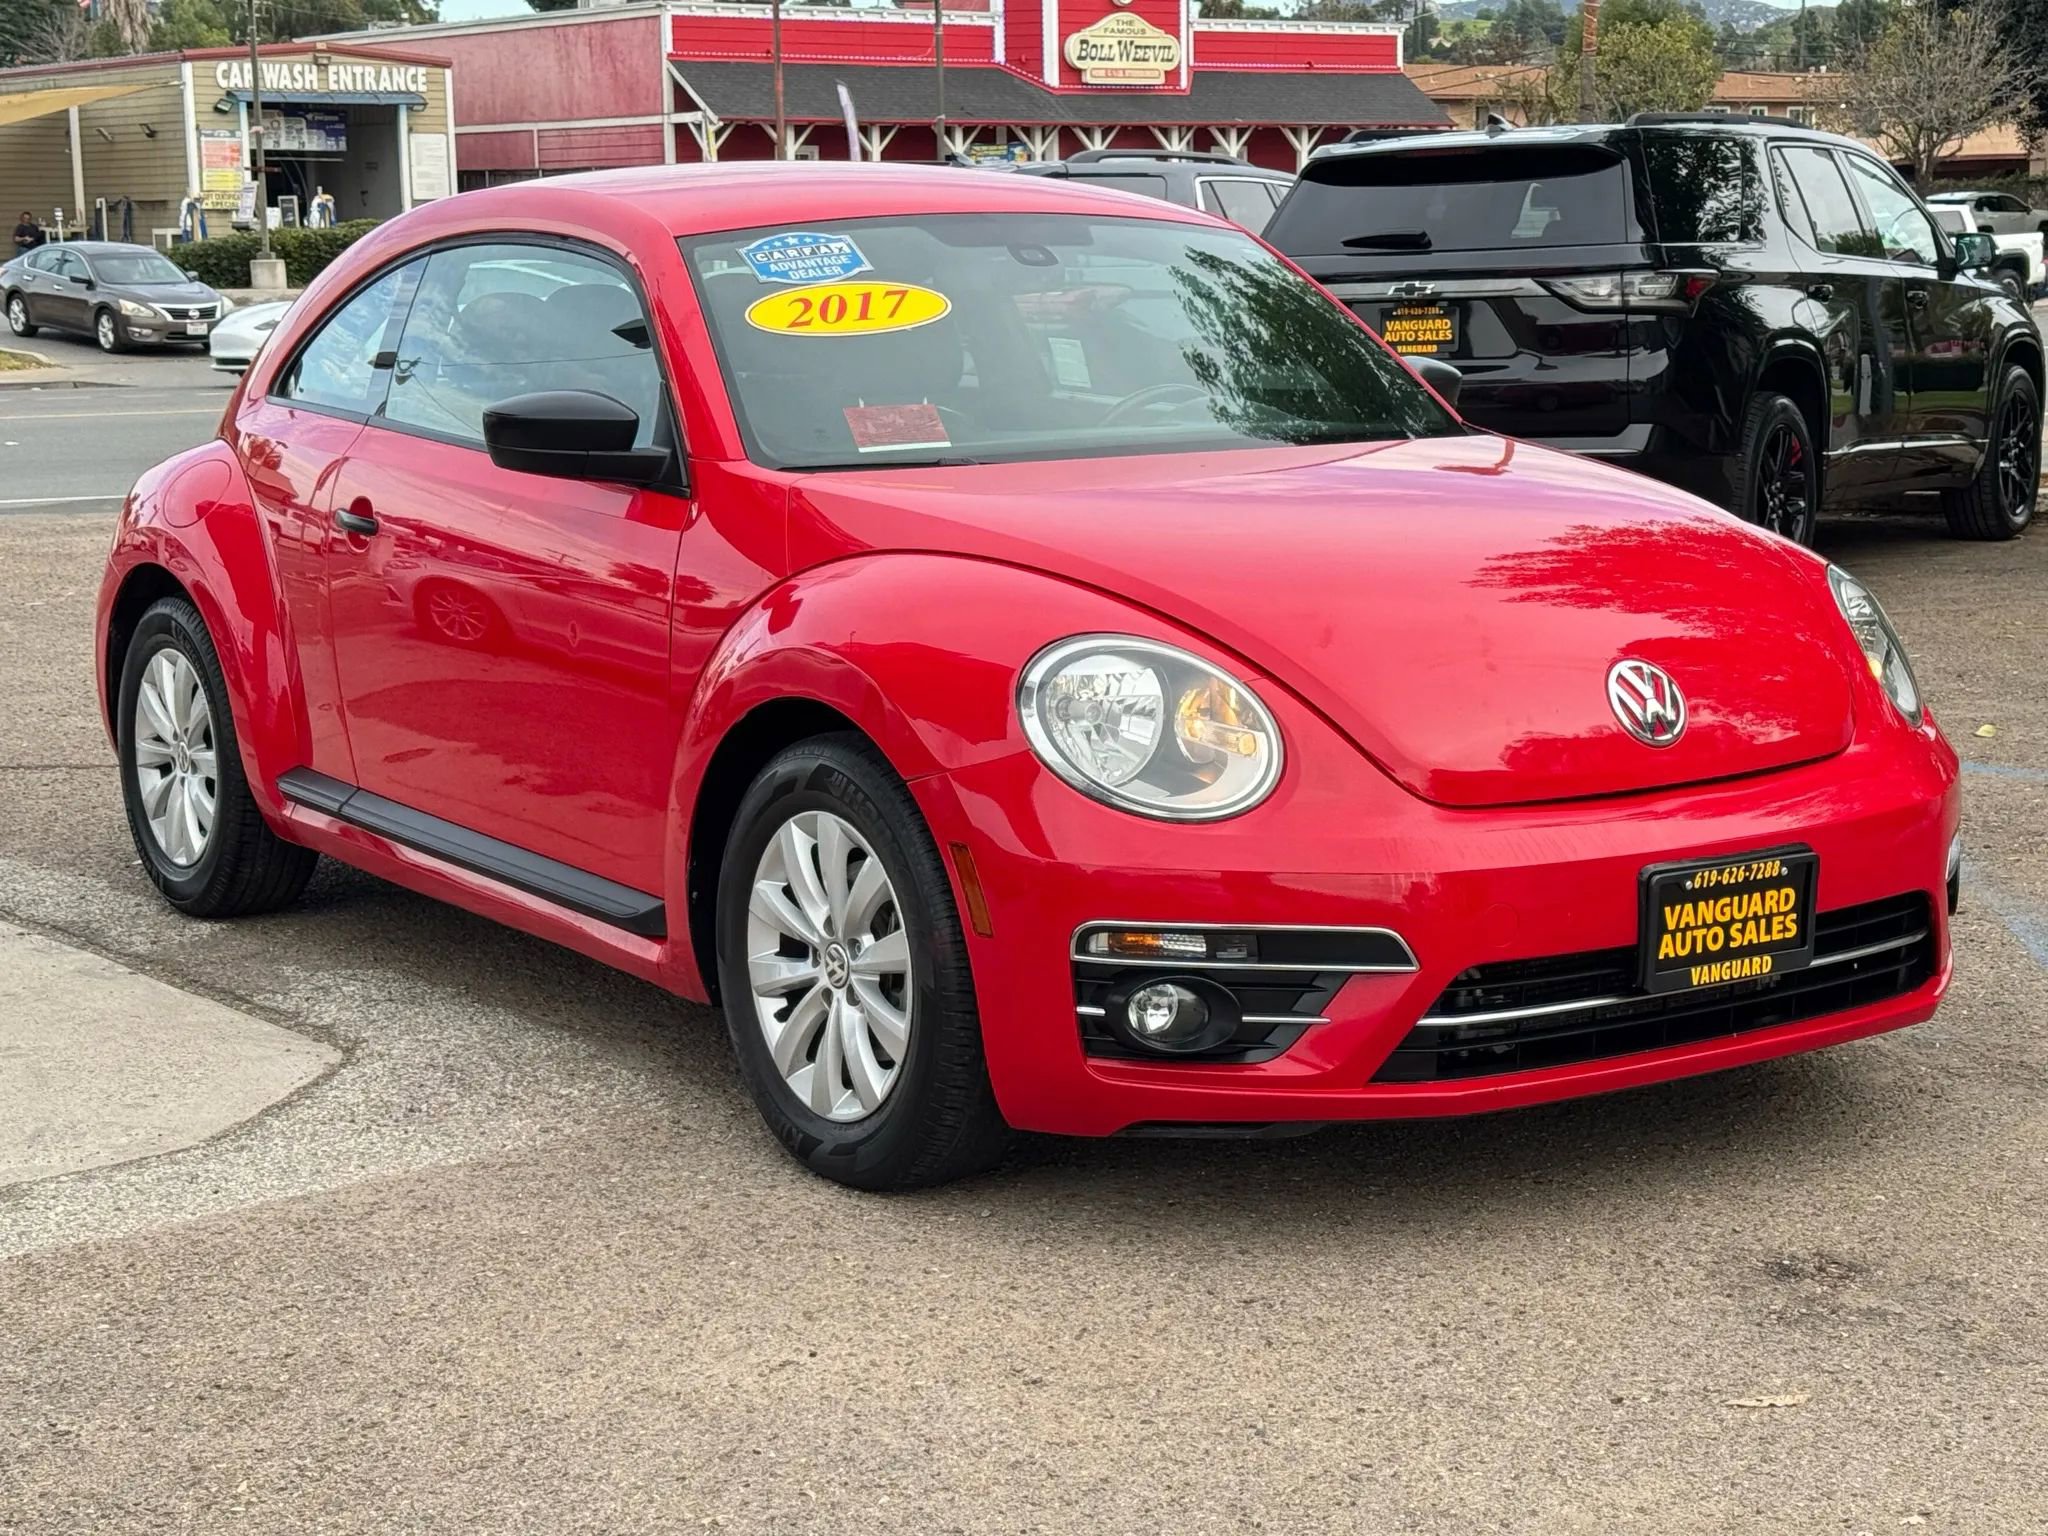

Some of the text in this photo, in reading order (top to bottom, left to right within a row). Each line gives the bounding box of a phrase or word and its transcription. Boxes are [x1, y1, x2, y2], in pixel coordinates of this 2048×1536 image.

[1103, 27, 1147, 35] FAMOUS
[1115, 19, 1135, 27] THE
[261, 63, 319, 90] WASH
[327, 65, 428, 92] ENTRANCE
[753, 243, 851, 263] CARFAX
[769, 254, 852, 273] ADVANTAGE
[788, 265, 844, 280] DEALER
[786, 289, 910, 329] 2017
[1385, 319, 1452, 331] VANGUARD
[1384, 330, 1453, 342] AUTO SALES
[1397, 344, 1438, 353] VANGUARD
[1693, 859, 1781, 889] 619-626-7288
[1664, 887, 1796, 931] VANGUARD
[1658, 913, 1798, 960] AUTO SALES
[1690, 955, 1773, 986] VANGUARD
